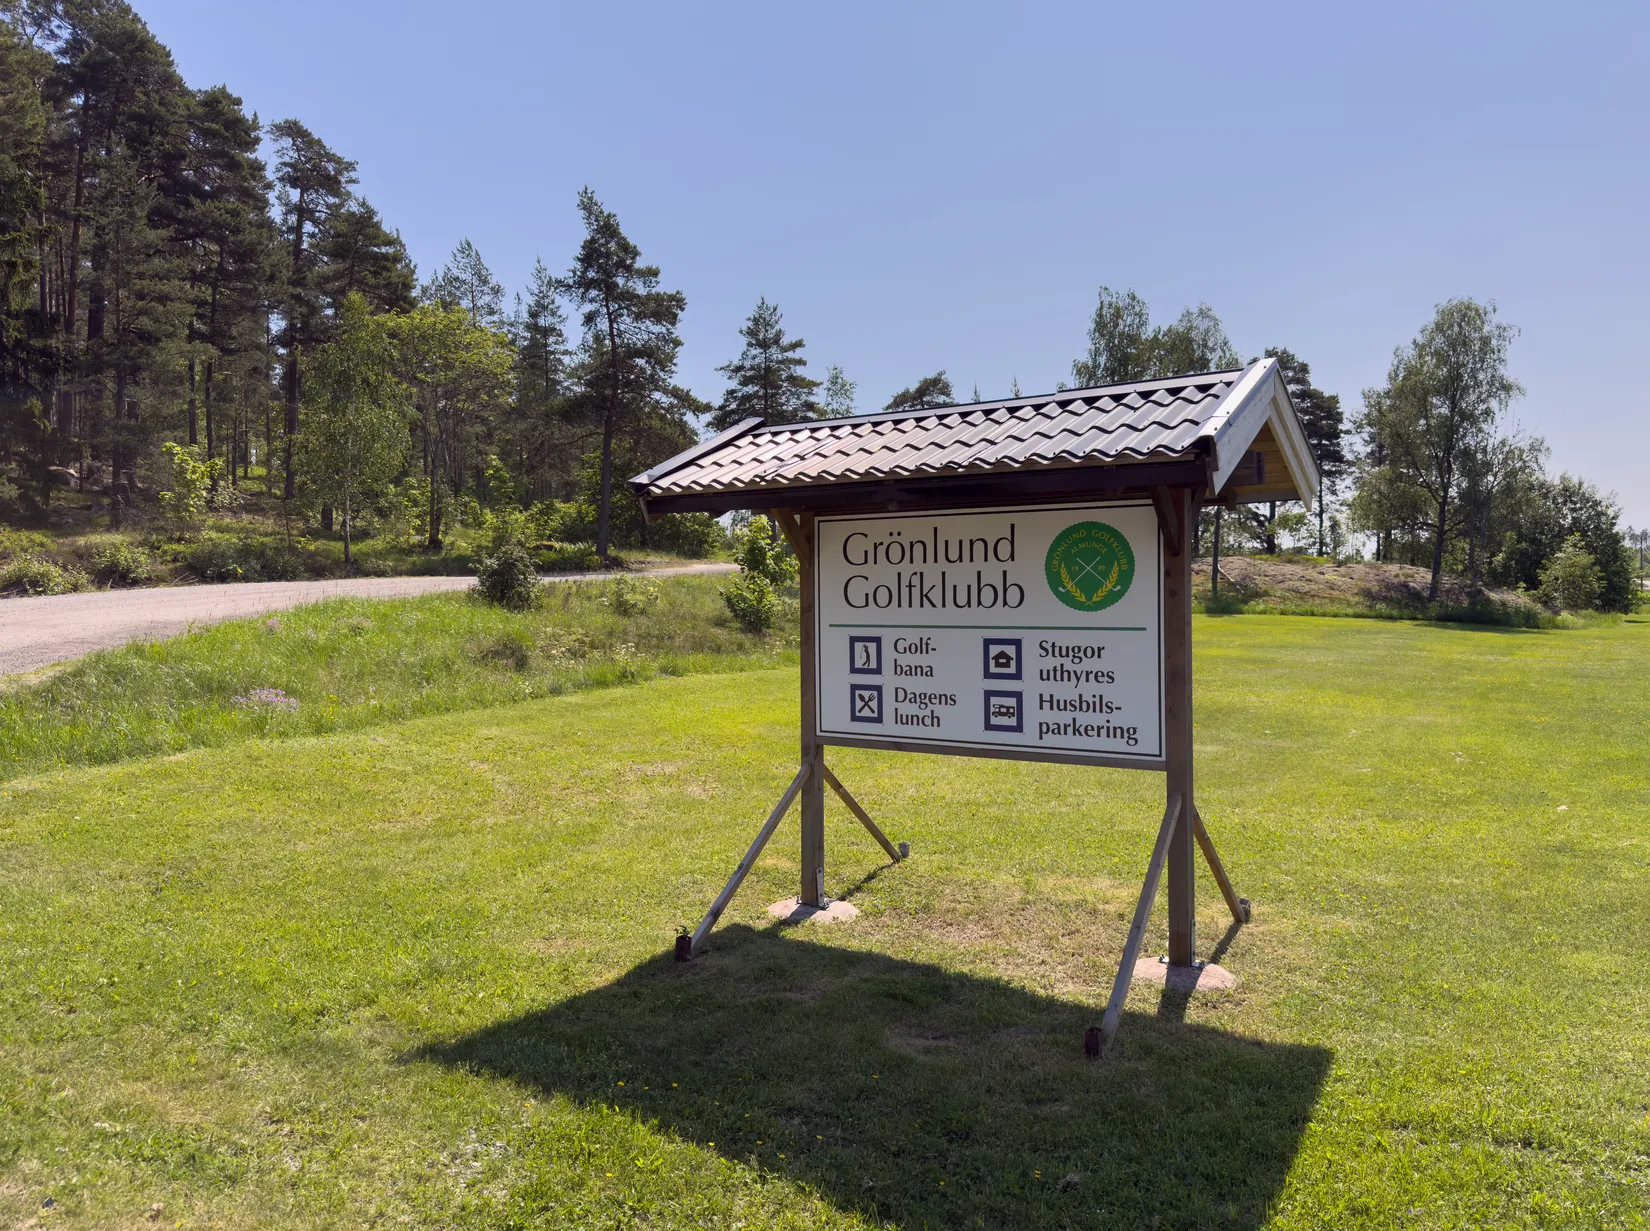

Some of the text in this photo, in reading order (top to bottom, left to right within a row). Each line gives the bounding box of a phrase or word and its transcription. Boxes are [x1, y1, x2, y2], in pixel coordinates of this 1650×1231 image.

[842, 523, 1016, 566] Grönlund
[1071, 541, 1108, 554] ALMUNGE
[1091, 529, 1128, 571] GOLFKLUBB
[844, 570, 1024, 608] Golfklubb
[894, 637, 936, 654] Golf-
[1039, 640, 1105, 665] Stugor
[894, 659, 934, 677] bana
[1040, 664, 1114, 688] uthyres
[895, 687, 956, 710] Dagens
[1039, 694, 1121, 714] Husbils-
[895, 708, 940, 727] lunch
[1038, 718, 1139, 746] parkering
